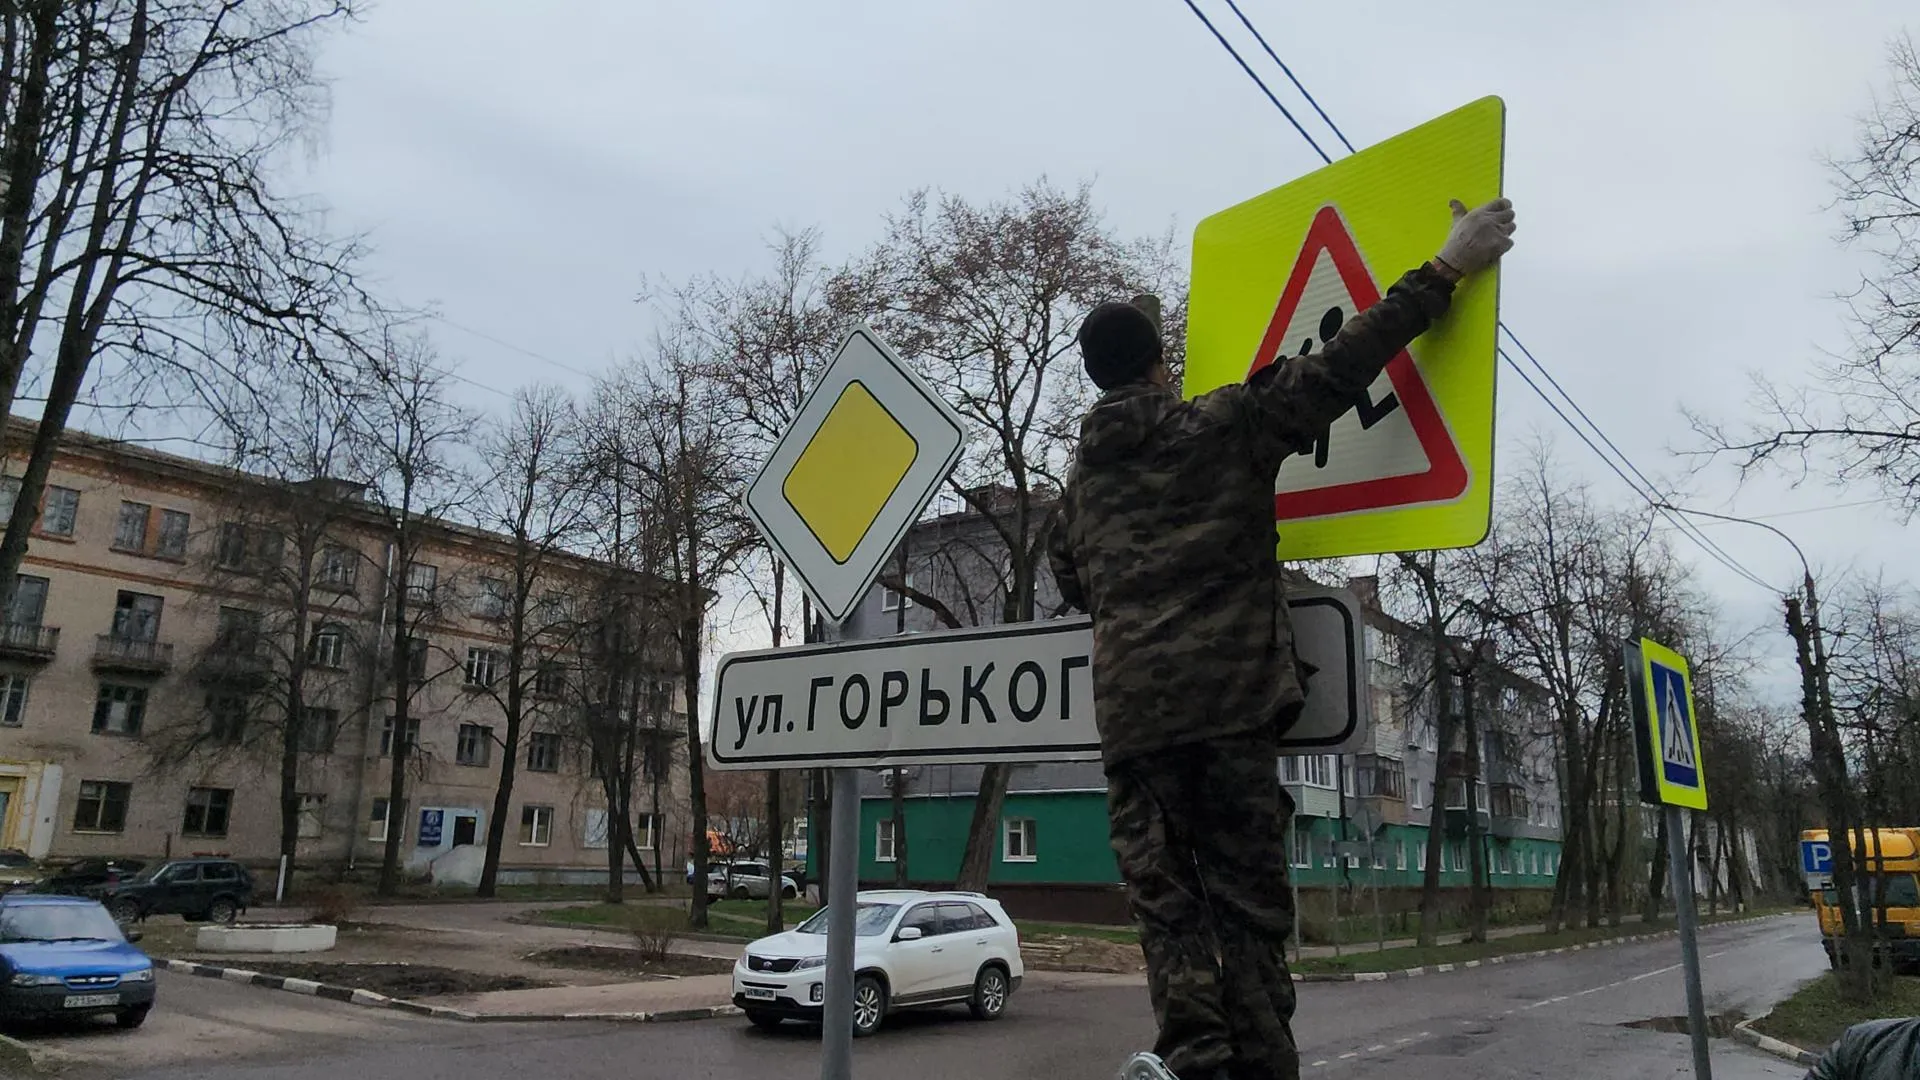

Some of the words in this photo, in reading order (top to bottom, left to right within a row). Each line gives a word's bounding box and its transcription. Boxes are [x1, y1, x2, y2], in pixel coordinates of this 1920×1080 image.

[734, 693, 795, 750] ул.
[807, 655, 1090, 732] ГОРЬКОГ
[1811, 843, 1832, 870] P
